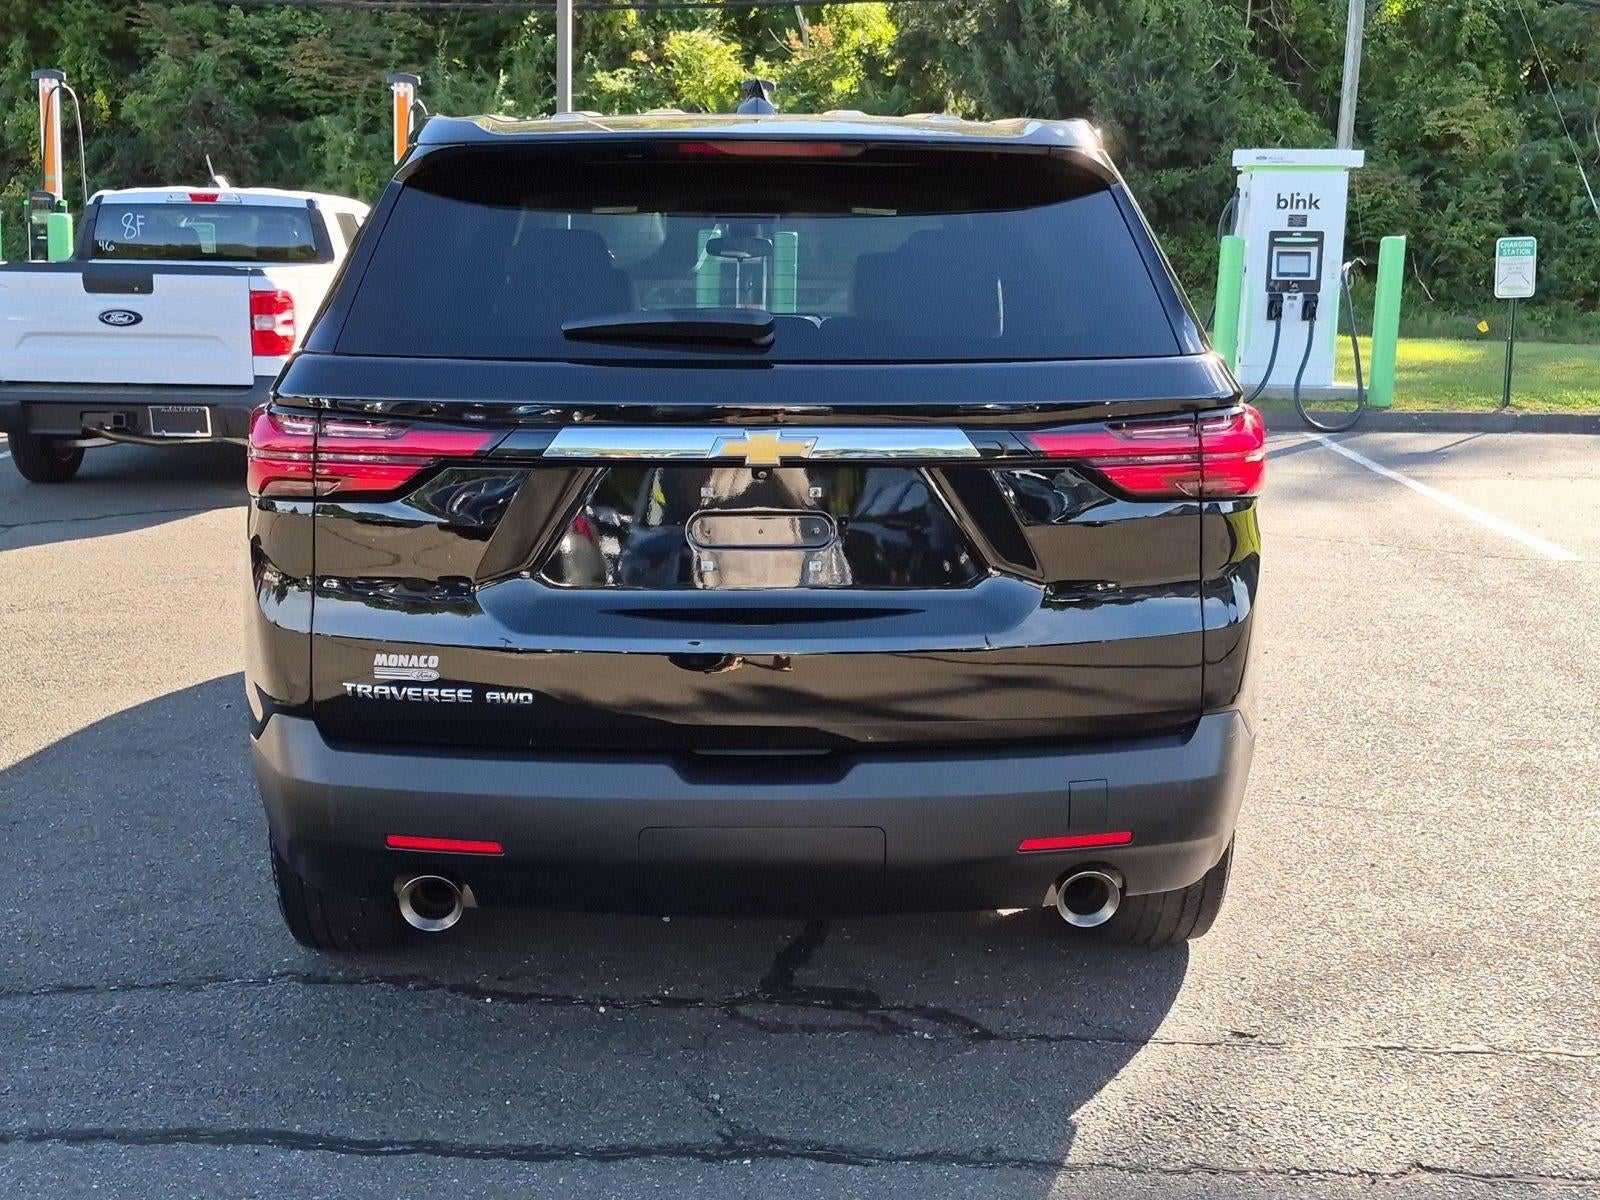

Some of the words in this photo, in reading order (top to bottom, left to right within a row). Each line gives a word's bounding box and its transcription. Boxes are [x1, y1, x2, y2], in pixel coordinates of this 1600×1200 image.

[1276, 192, 1321, 210] blink
[121, 212, 145, 240] 8F
[1500, 240, 1534, 249] CHARGING
[373, 653, 439, 668] MONACO
[342, 682, 473, 703] TRAVERSE
[485, 691, 533, 705] AWD
